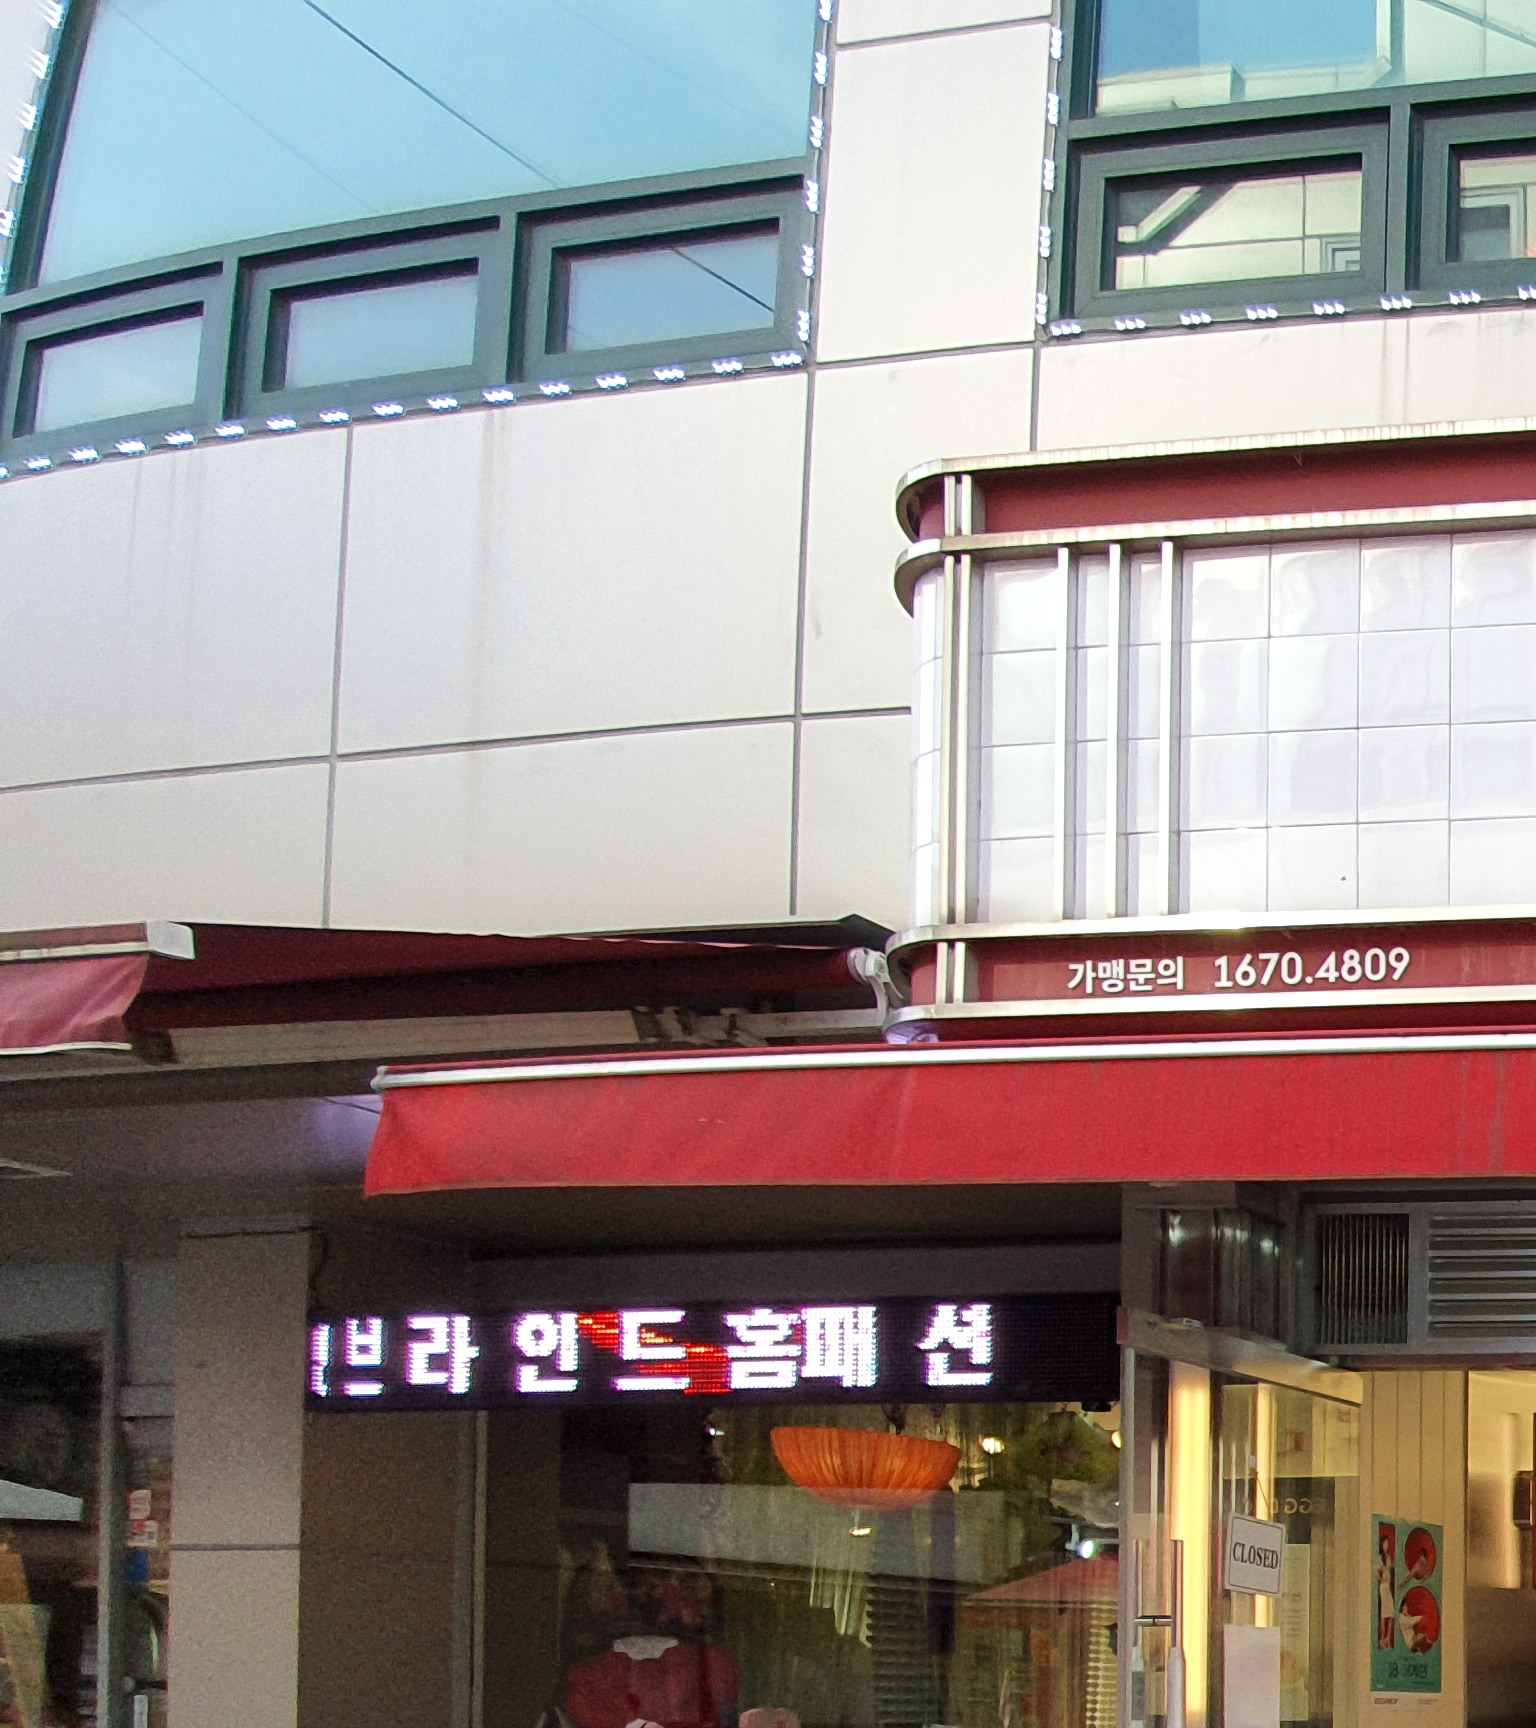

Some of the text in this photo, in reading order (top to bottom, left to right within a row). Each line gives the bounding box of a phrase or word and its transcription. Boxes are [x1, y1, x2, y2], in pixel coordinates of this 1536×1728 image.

[1067, 946, 1411, 994] 가맹문의 1670.4809
[1233, 1542, 1278, 1570] CLOSED
